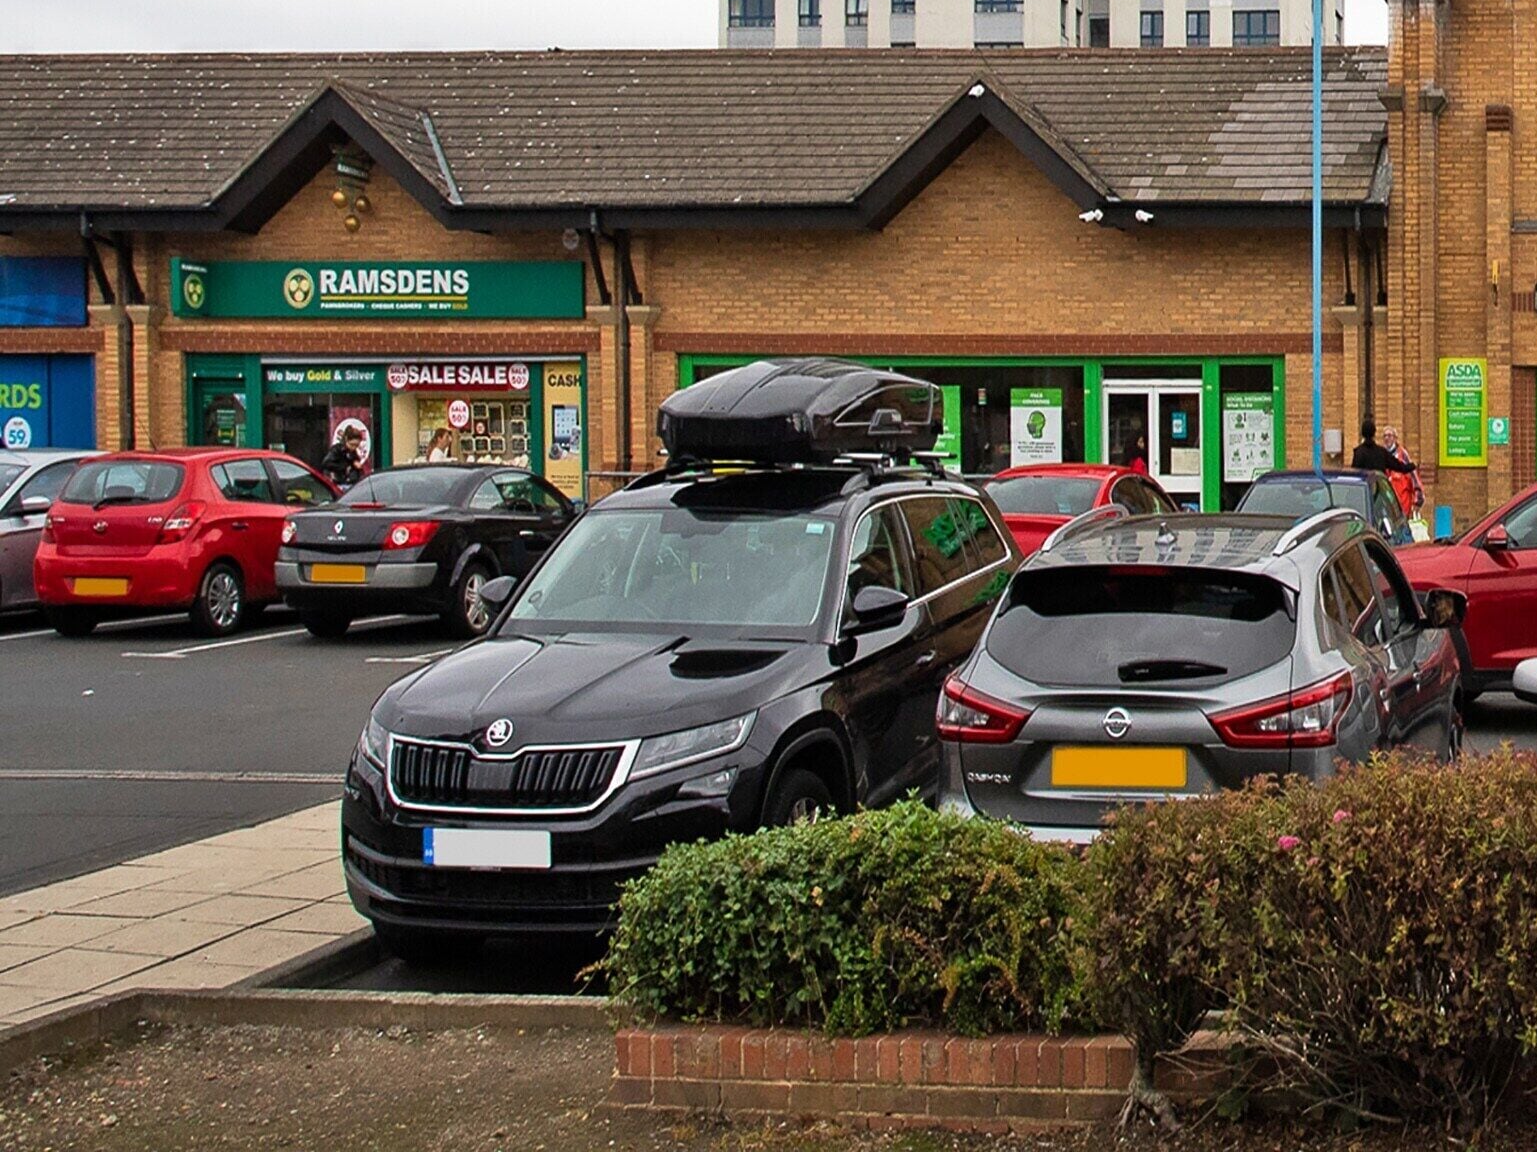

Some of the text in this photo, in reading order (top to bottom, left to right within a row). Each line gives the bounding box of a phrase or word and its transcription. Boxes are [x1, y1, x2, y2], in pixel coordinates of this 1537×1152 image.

[319, 269, 469, 294] RAMSDENS
[320, 302, 365, 310] PAWNBROKERS
[267, 369, 375, 383] We buy Gold & Silver
[408, 365, 508, 385] SALE SALE
[1447, 364, 1482, 377] ASDA
[547, 374, 581, 387] CASH
